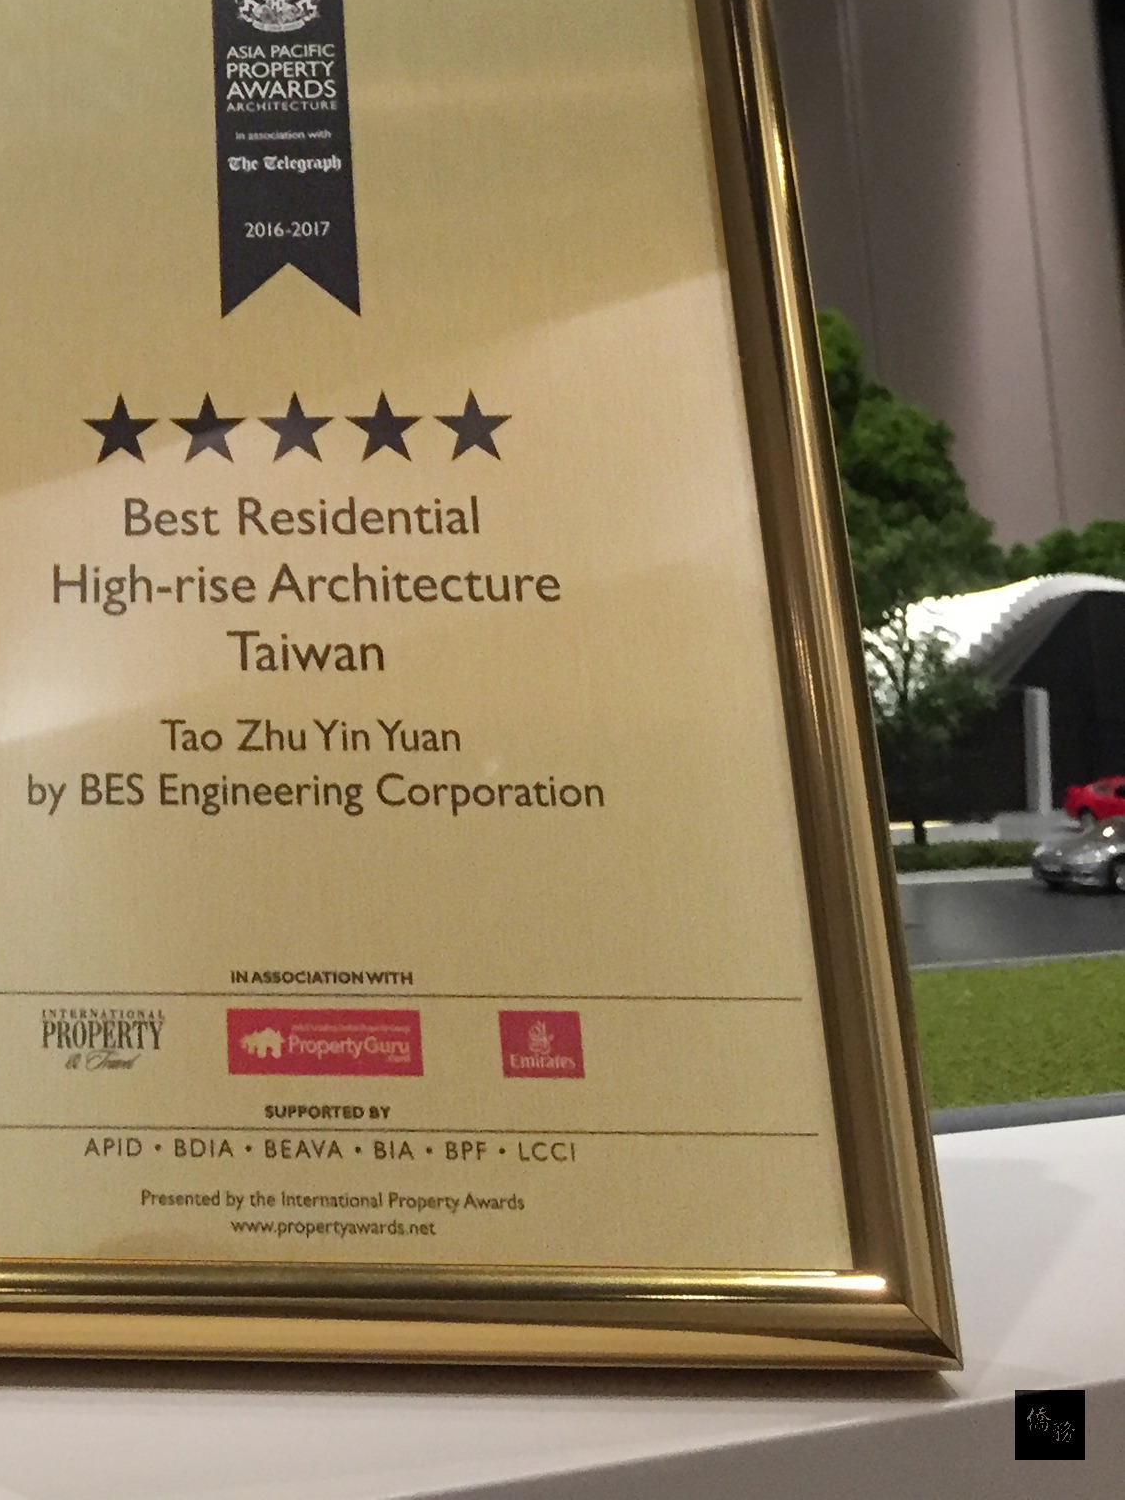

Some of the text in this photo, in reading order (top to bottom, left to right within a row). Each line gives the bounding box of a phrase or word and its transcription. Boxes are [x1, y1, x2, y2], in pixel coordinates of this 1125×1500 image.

[226, 43, 335, 59] ASIA PACIFIC
[226, 60, 335, 79] PROPERTY
[226, 79, 337, 100] AWARDS
[226, 100, 338, 113] ARCHITECTURE
[307, 129, 332, 139] with
[227, 154, 342, 174] The Telegraph
[245, 221, 331, 239] 2016-2017
[123, 495, 480, 537] Best Residential
[52, 562, 562, 616] High-rise Architecture
[226, 629, 386, 673] Taiwan
[161, 718, 462, 753] Tao Zhu Yin Yuan
[27, 773, 606, 816] by BES Engineering Corporation
[230, 970, 413, 986] IN ASSOCIATION WITH
[41, 1008, 165, 1020] INTERNATIONAL
[42, 1020, 164, 1050] PROPERTY
[264, 1105, 391, 1120] SUPPORTED BY
[84, 1137, 576, 1163] APID BDIA BEAVA BIA BPF LCCI
[141, 1189, 525, 1214] Presented by the International Property Awards
[230, 1219, 437, 1239] www.propertyawards.net
